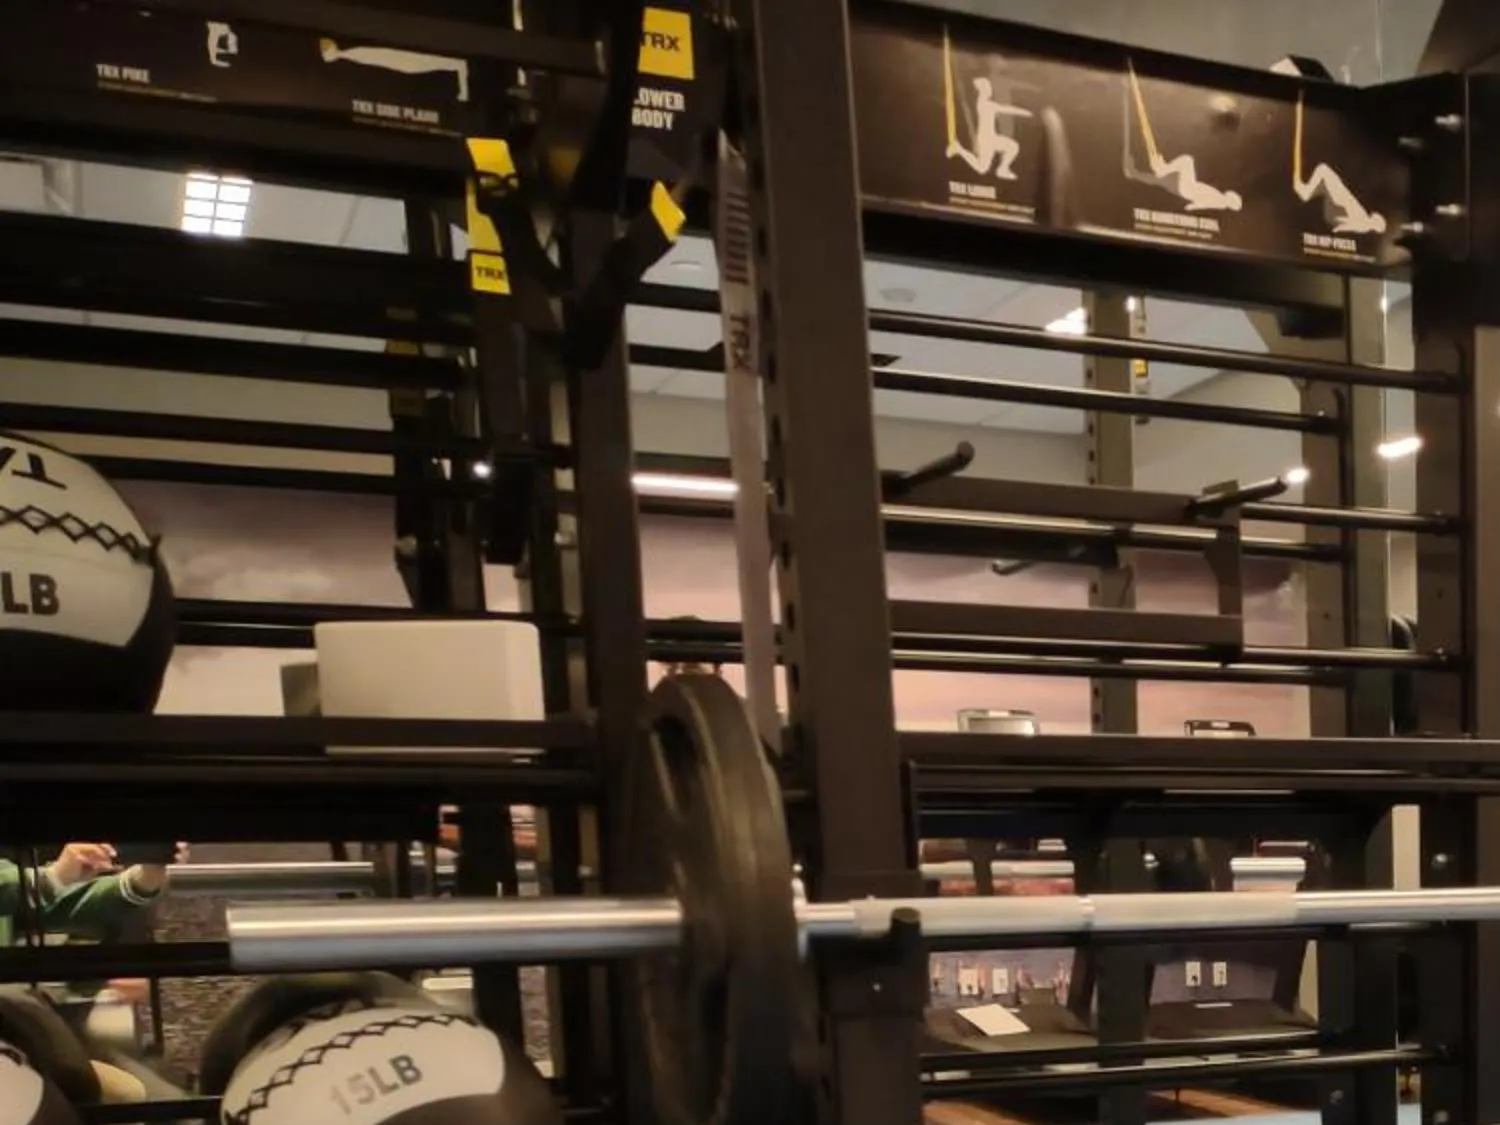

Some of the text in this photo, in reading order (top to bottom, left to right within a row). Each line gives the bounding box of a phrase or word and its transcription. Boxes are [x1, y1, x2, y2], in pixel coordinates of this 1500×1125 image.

[634, 88, 685, 112] OWER
[632, 107, 673, 131] BODY
[476, 265, 504, 280] TRX
[330, 1054, 423, 1116] 15LB
